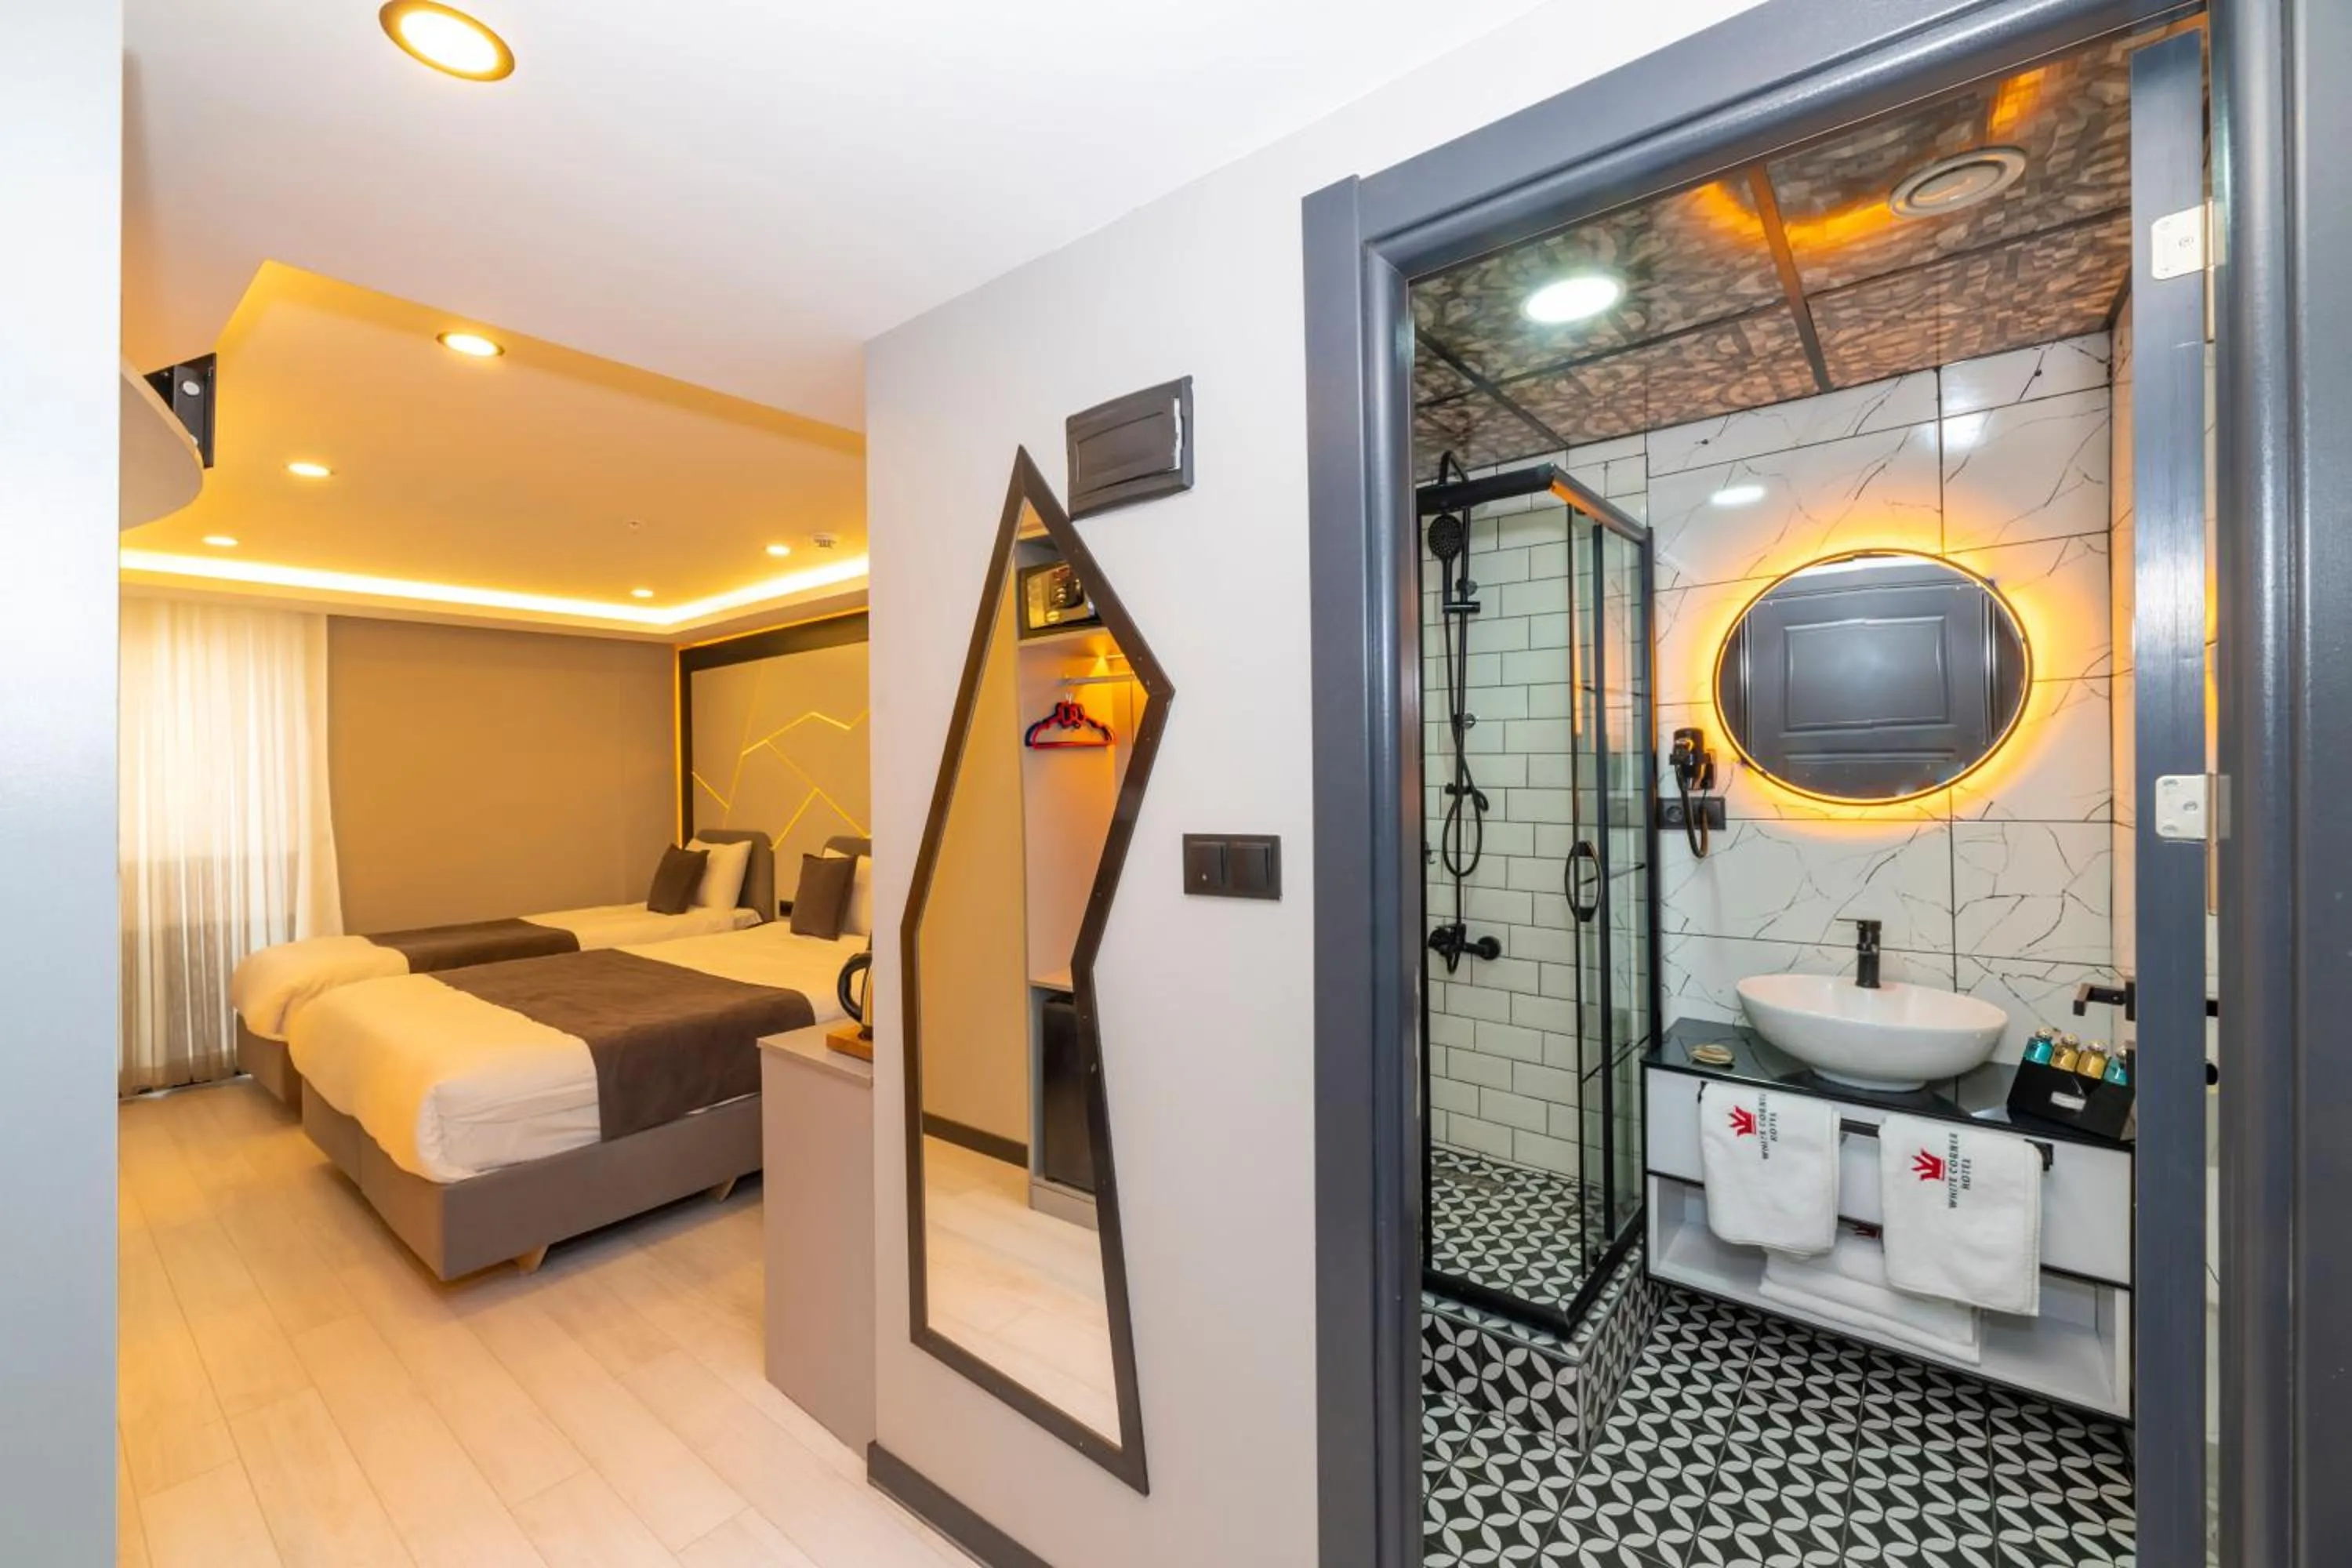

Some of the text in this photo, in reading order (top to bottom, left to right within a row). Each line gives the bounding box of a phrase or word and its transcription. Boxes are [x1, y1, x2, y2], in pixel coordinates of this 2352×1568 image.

[1769, 1112, 1778, 1142] HOTEL
[1759, 1130, 1769, 1160] WHITE
[1948, 1133, 1958, 1208] WHITE CORNER
[1962, 1159, 1971, 1190] HOTEL
